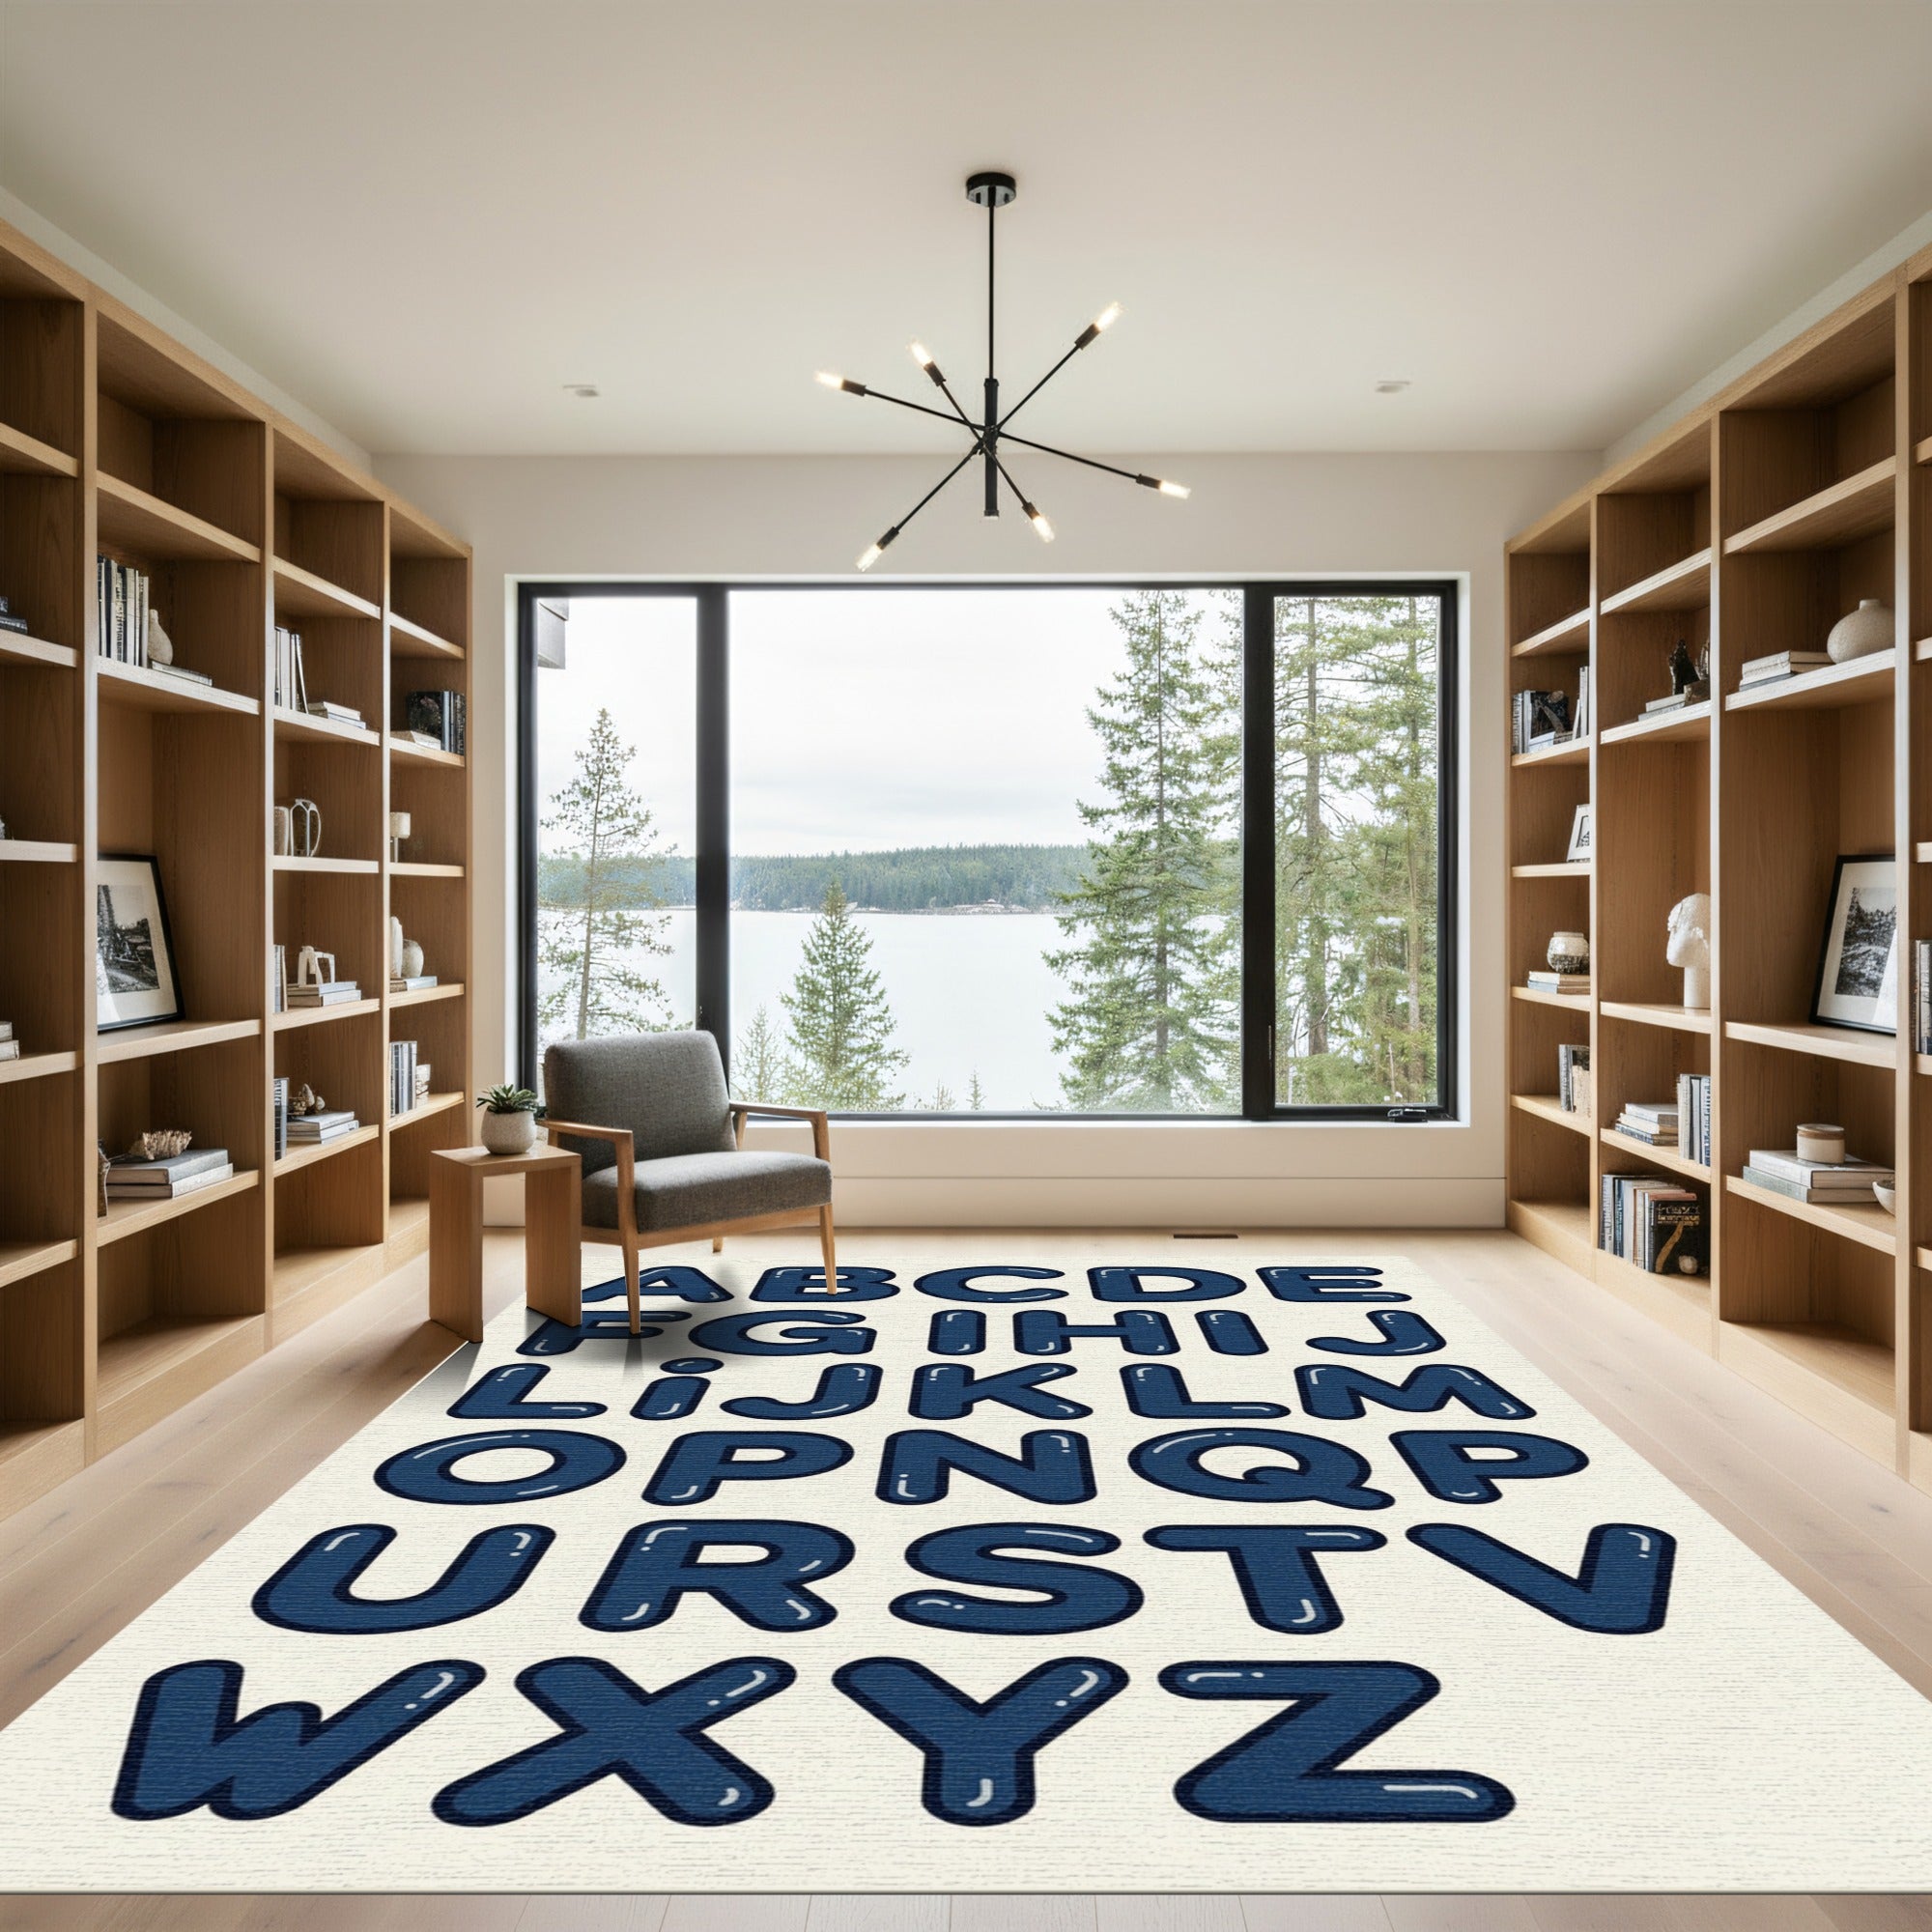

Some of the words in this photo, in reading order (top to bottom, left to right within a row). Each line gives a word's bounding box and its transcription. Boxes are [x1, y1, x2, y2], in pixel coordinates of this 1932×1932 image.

[581, 1266, 734, 1303] A
[749, 1266, 900, 1302] B
[914, 1266, 1068, 1303] C
[1087, 1266, 1247, 1302] D
[1256, 1266, 1412, 1302] E
[515, 1310, 693, 1356] F
[688, 1310, 877, 1356] G
[927, 1310, 986, 1355] I
[1012, 1310, 1180, 1355] H
[1195, 1310, 1269, 1355] I
[1306, 1310, 1446, 1356] J
[446, 1363, 608, 1419] L
[630, 1357, 724, 1420] i
[720, 1363, 883, 1420] J
[908, 1363, 1093, 1420] K
[1120, 1363, 1291, 1419] L
[1293, 1364, 1537, 1420] M
[374, 1429, 627, 1505] O
[641, 1431, 854, 1506] P
[875, 1430, 1097, 1505] N
[1127, 1428, 1395, 1510] Q
[1389, 1431, 1589, 1504] P
[251, 1523, 556, 1634] U
[579, 1520, 855, 1633] R
[889, 1522, 1144, 1635] S
[1143, 1525, 1387, 1634] T
[1406, 1523, 1677, 1634] V
[111, 1660, 486, 1821] W
[431, 1657, 797, 1827] X
[832, 1657, 1129, 1827] Y
[1157, 1661, 1516, 1823] Z
